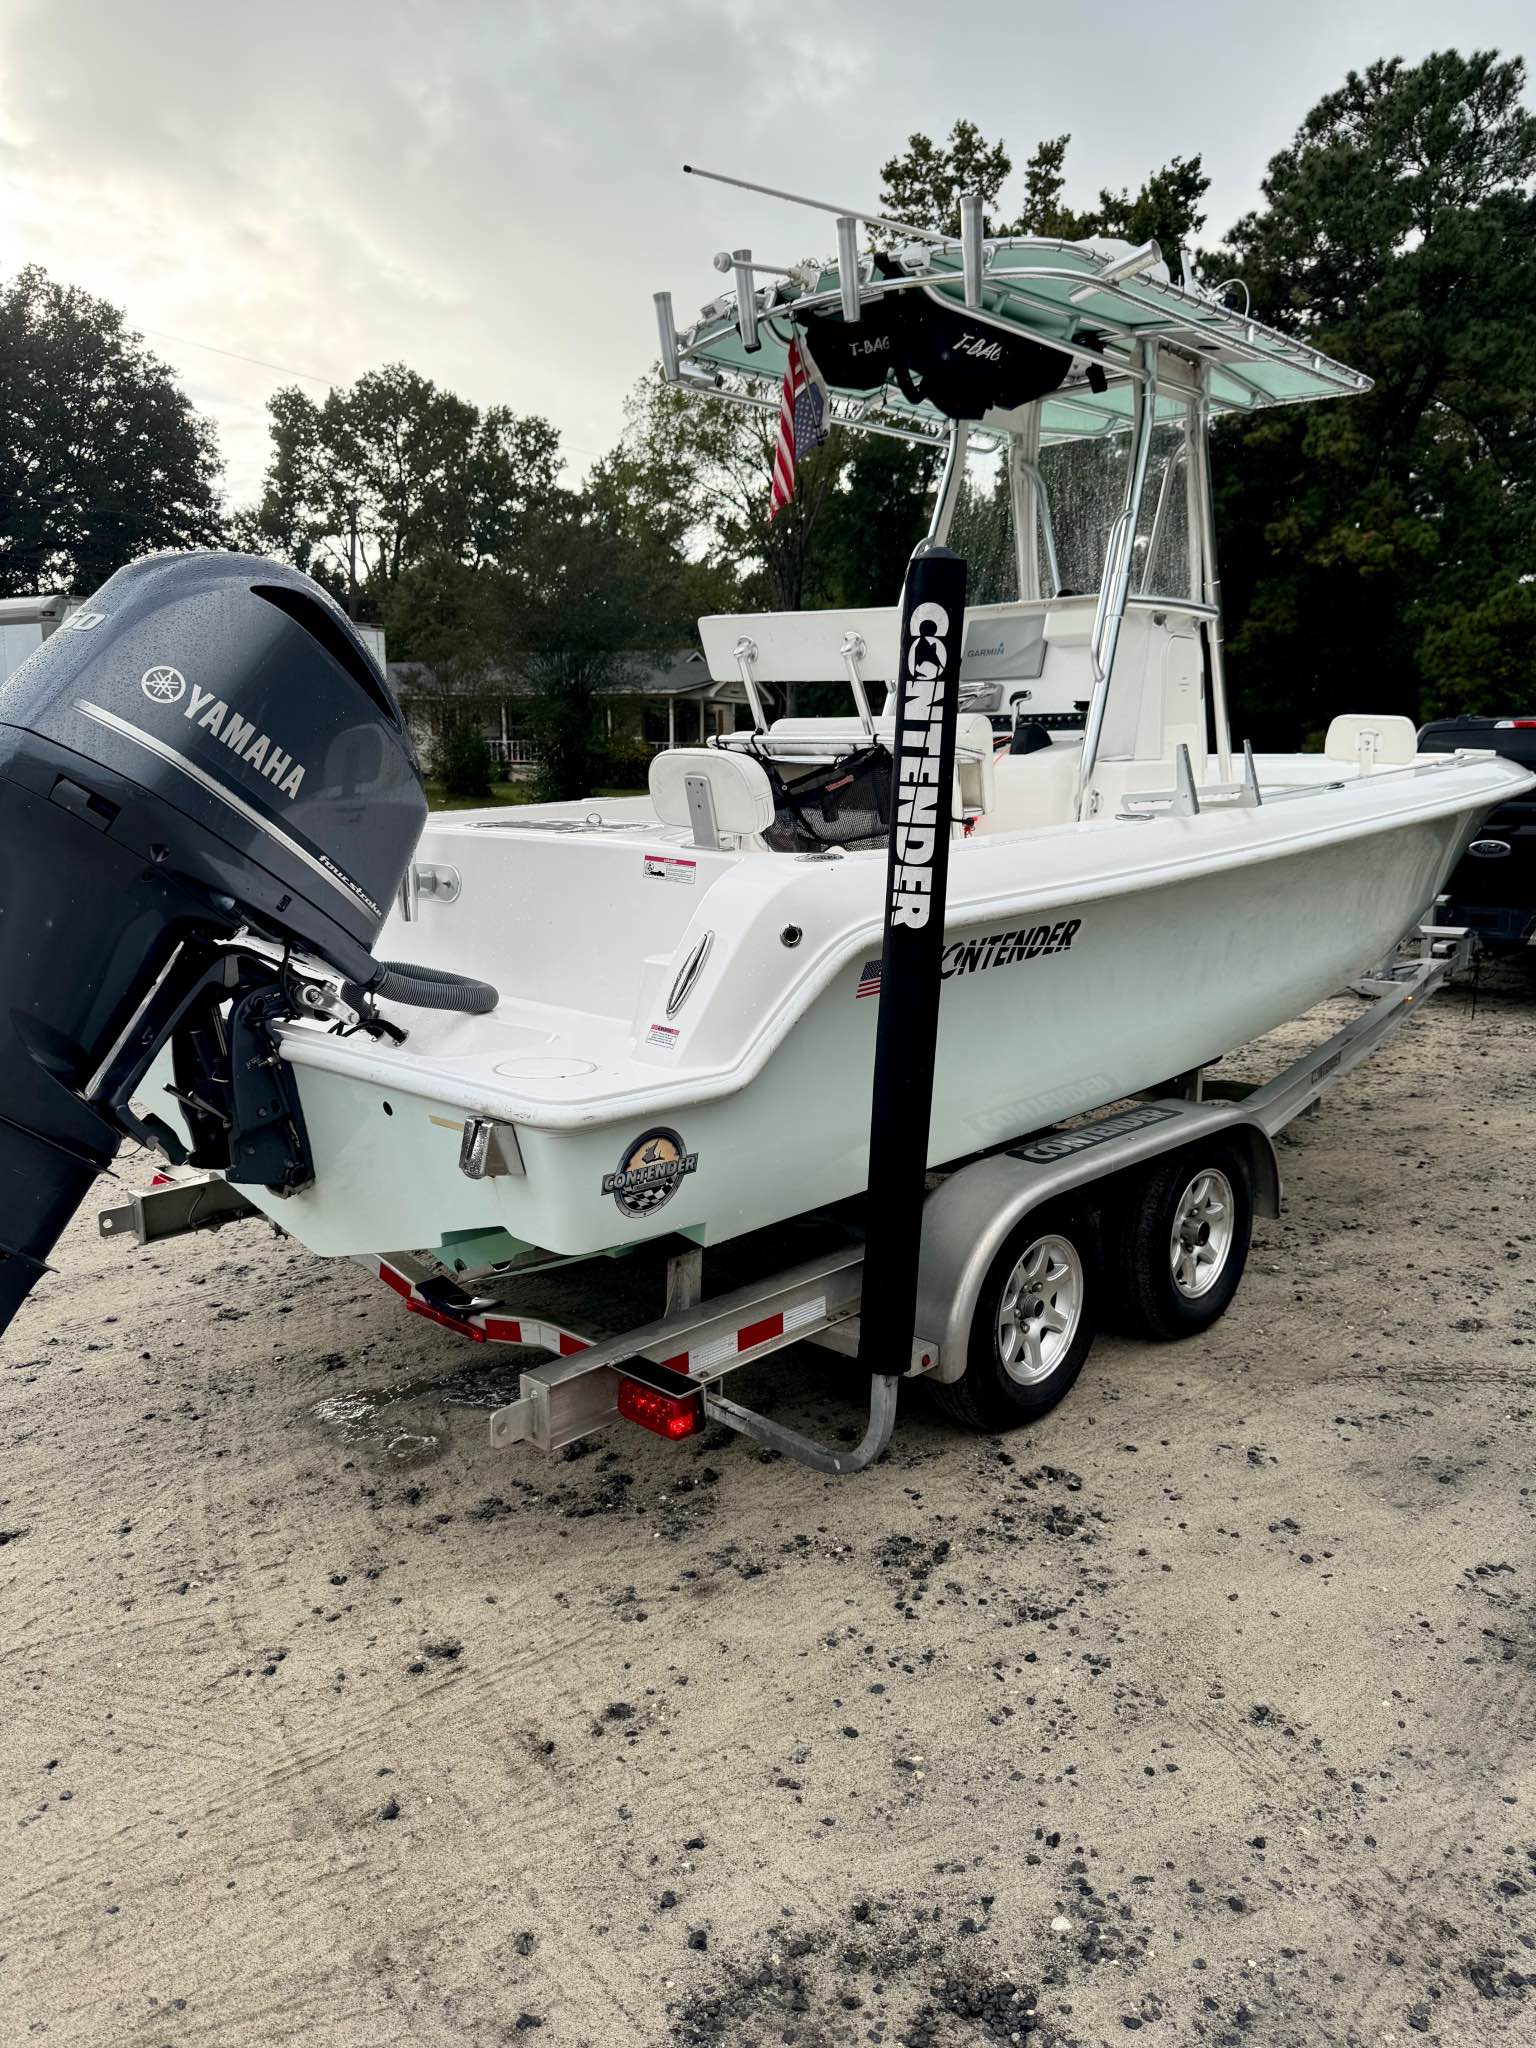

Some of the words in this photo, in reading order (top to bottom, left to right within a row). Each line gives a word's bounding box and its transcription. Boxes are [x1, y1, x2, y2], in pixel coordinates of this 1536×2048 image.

[848, 335, 891, 356] T-BAG
[952, 332, 1003, 361] T-BAG
[967, 647, 1005, 658] GARMIN
[183, 683, 306, 800] YAMAHA
[890, 601, 950, 930] CONTENDER
[940, 918, 1082, 980] ONTENDER
[1023, 1108, 1174, 1160] CONTENDER
[603, 1154, 696, 1191] CONTENDER
